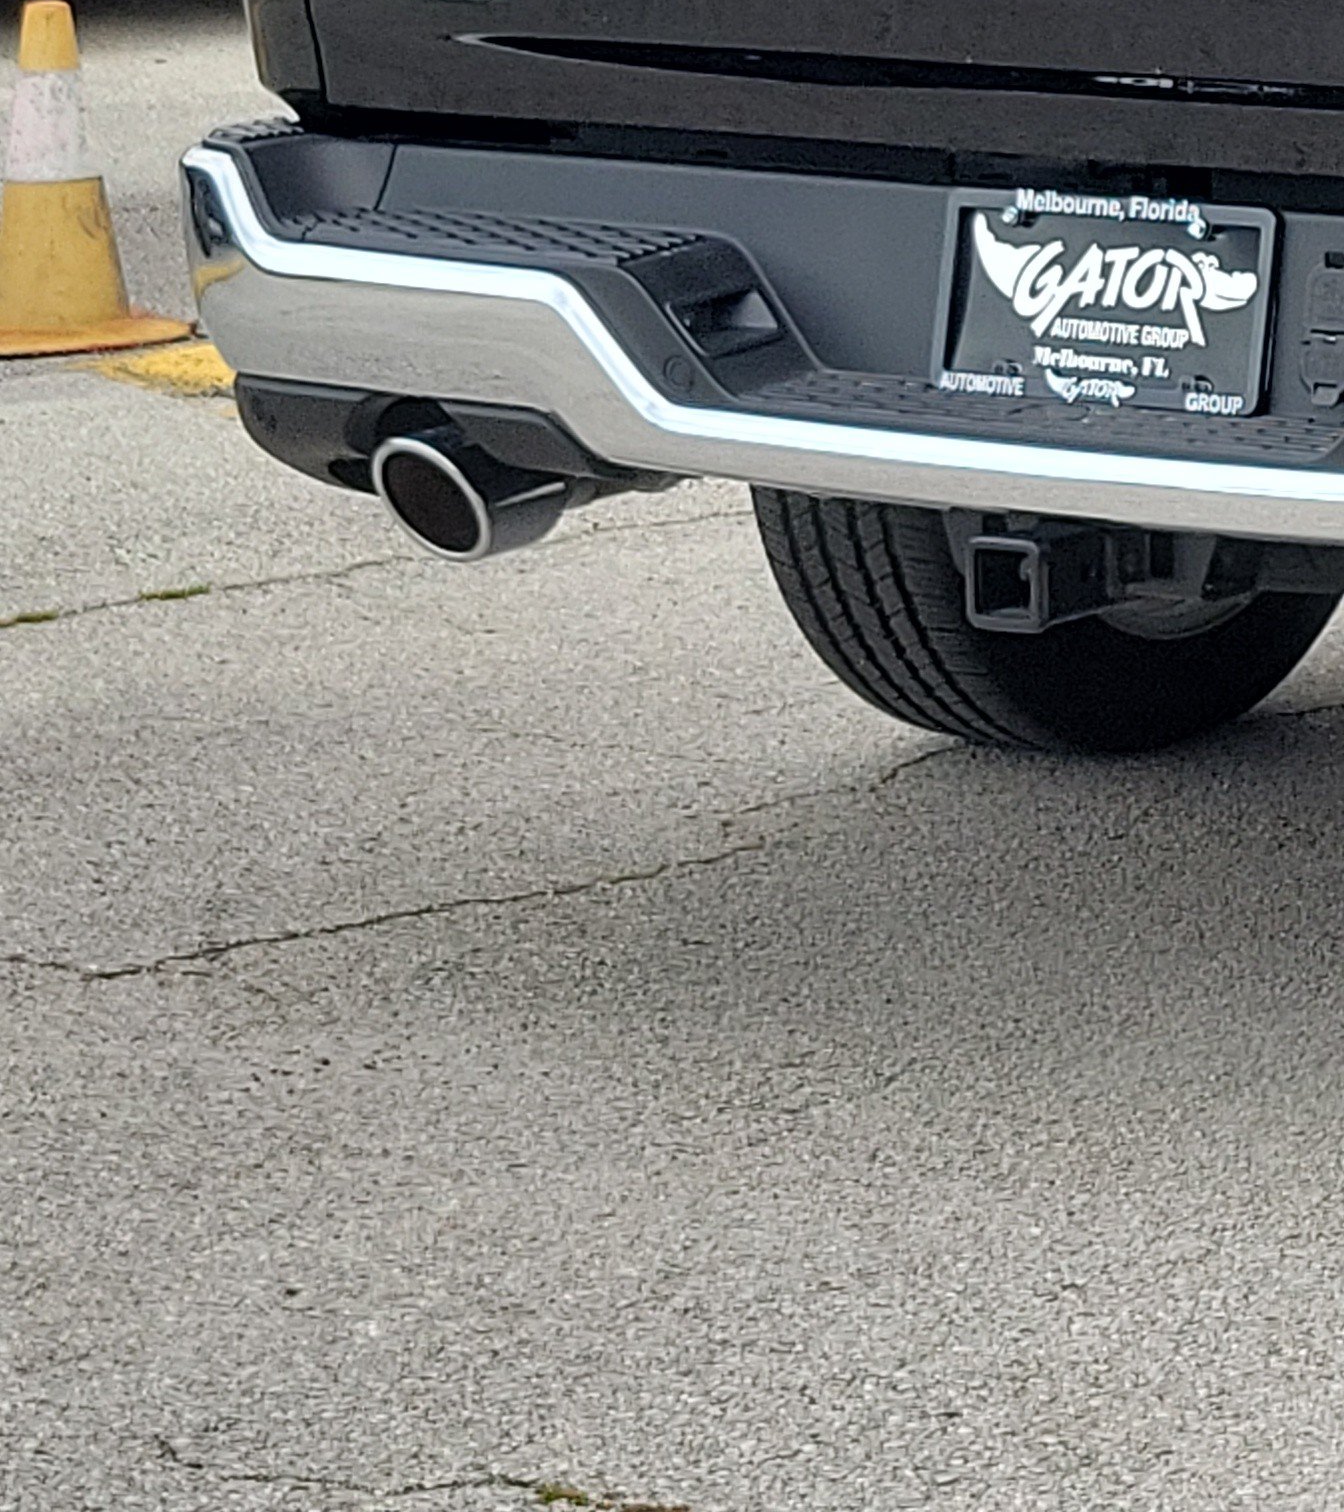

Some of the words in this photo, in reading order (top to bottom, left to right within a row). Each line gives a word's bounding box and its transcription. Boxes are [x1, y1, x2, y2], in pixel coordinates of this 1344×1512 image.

[1016, 188, 1125, 222] Melbourne,
[1129, 195, 1201, 222] Florida
[1013, 240, 1206, 348] GATOR
[1050, 316, 1141, 346] AUTOMOTIVE
[1141, 325, 1190, 350] GROUP
[1032, 345, 1138, 376] Melbourne,
[940, 370, 1024, 397] AUTOMOTIVE
[1184, 392, 1244, 416] GROUP
